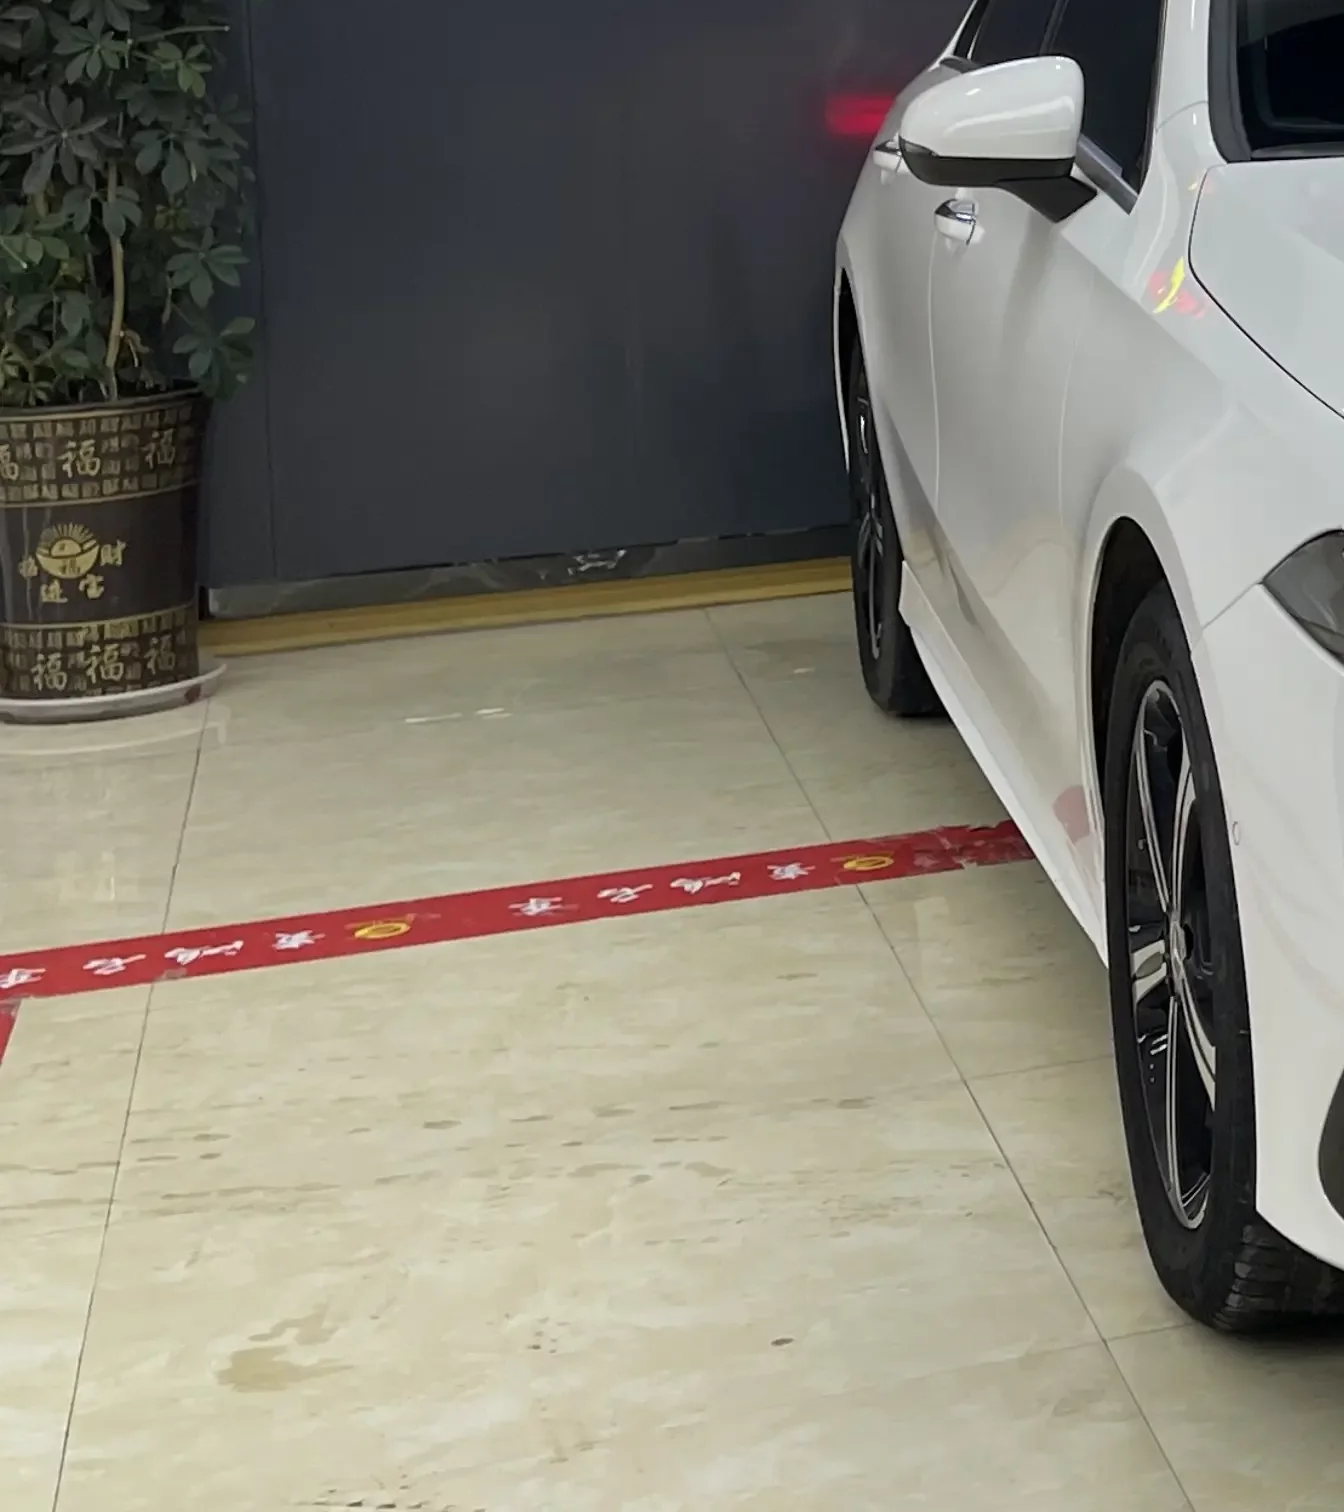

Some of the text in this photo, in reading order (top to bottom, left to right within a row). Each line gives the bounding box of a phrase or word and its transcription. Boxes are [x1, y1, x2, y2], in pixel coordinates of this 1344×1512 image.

[57, 439, 100, 478] 福
[31, 652, 68, 691] 福
[85, 643, 124, 684] 福
